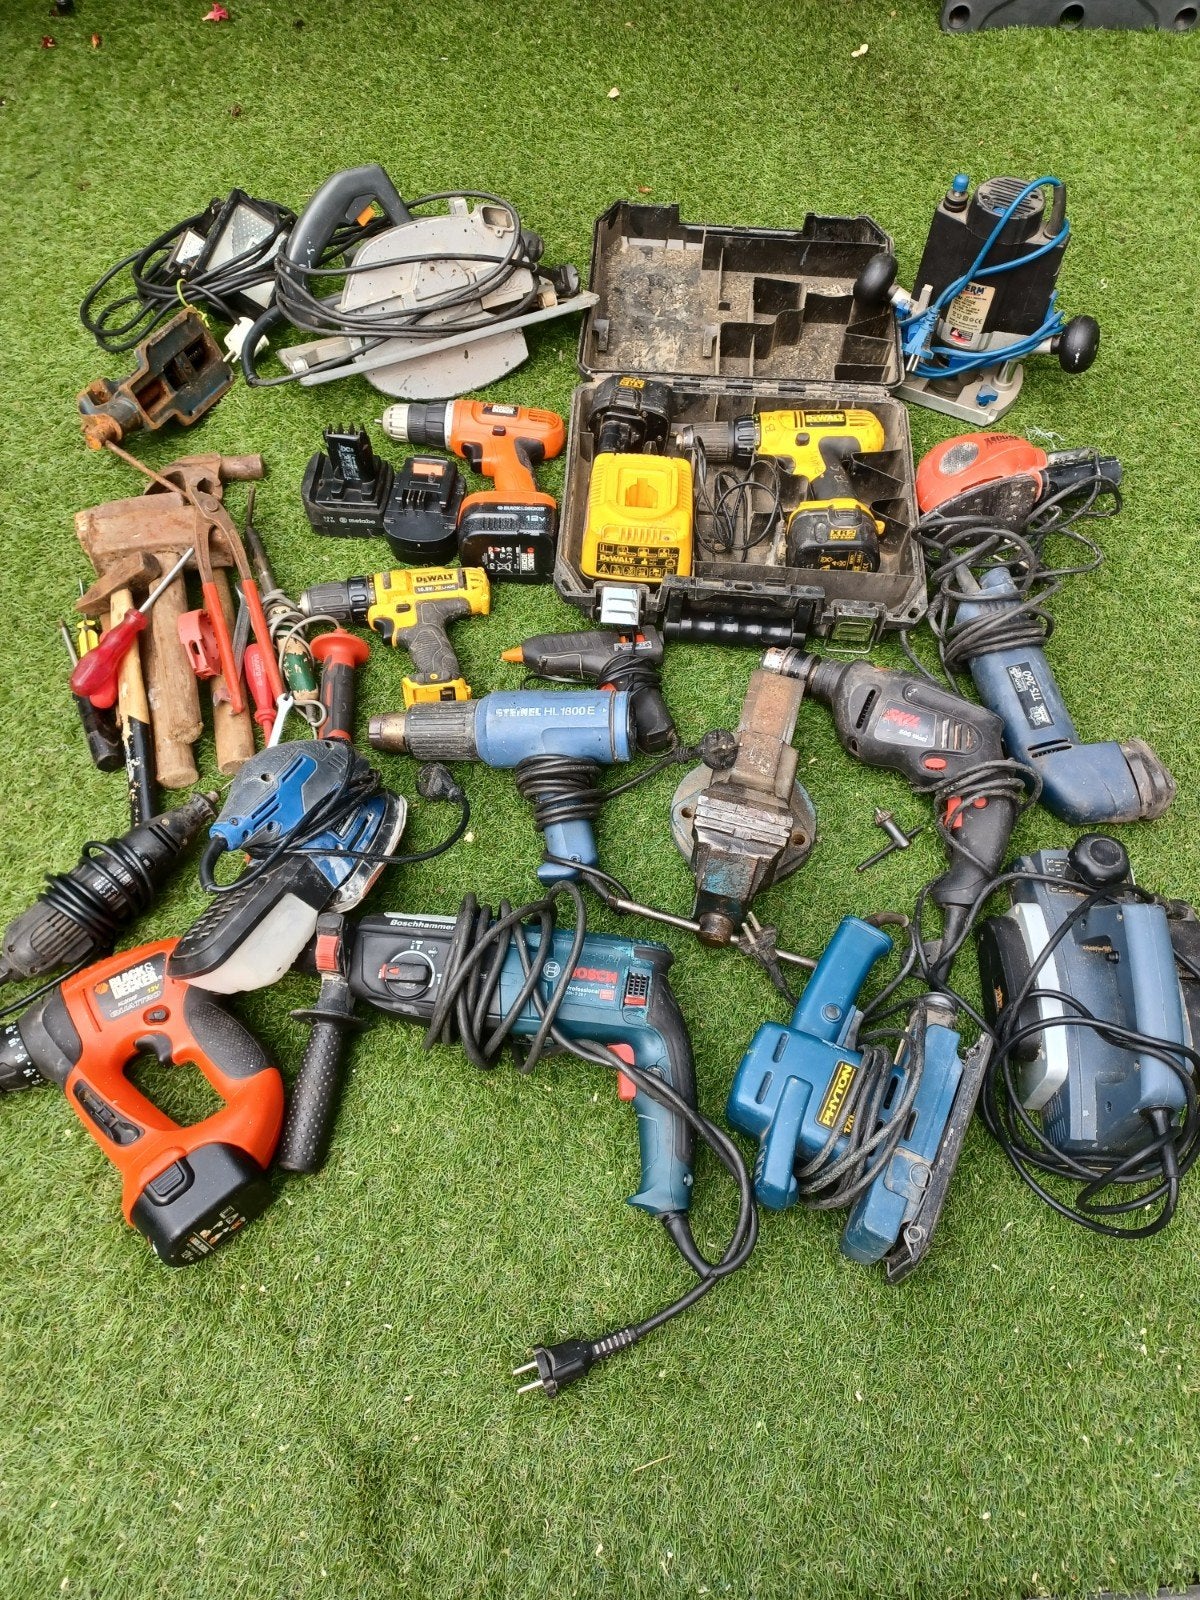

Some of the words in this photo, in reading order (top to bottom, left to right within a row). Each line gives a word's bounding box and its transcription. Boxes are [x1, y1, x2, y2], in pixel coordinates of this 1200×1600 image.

[963, 284, 984, 294] ERM
[495, 707, 541, 717] STEINEL
[544, 707, 559, 716] HL
[561, 706, 586, 716] 1800
[587, 706, 595, 715] E
[389, 919, 456, 930] Boschhammer
[822, 1064, 853, 1126] PHYTON
